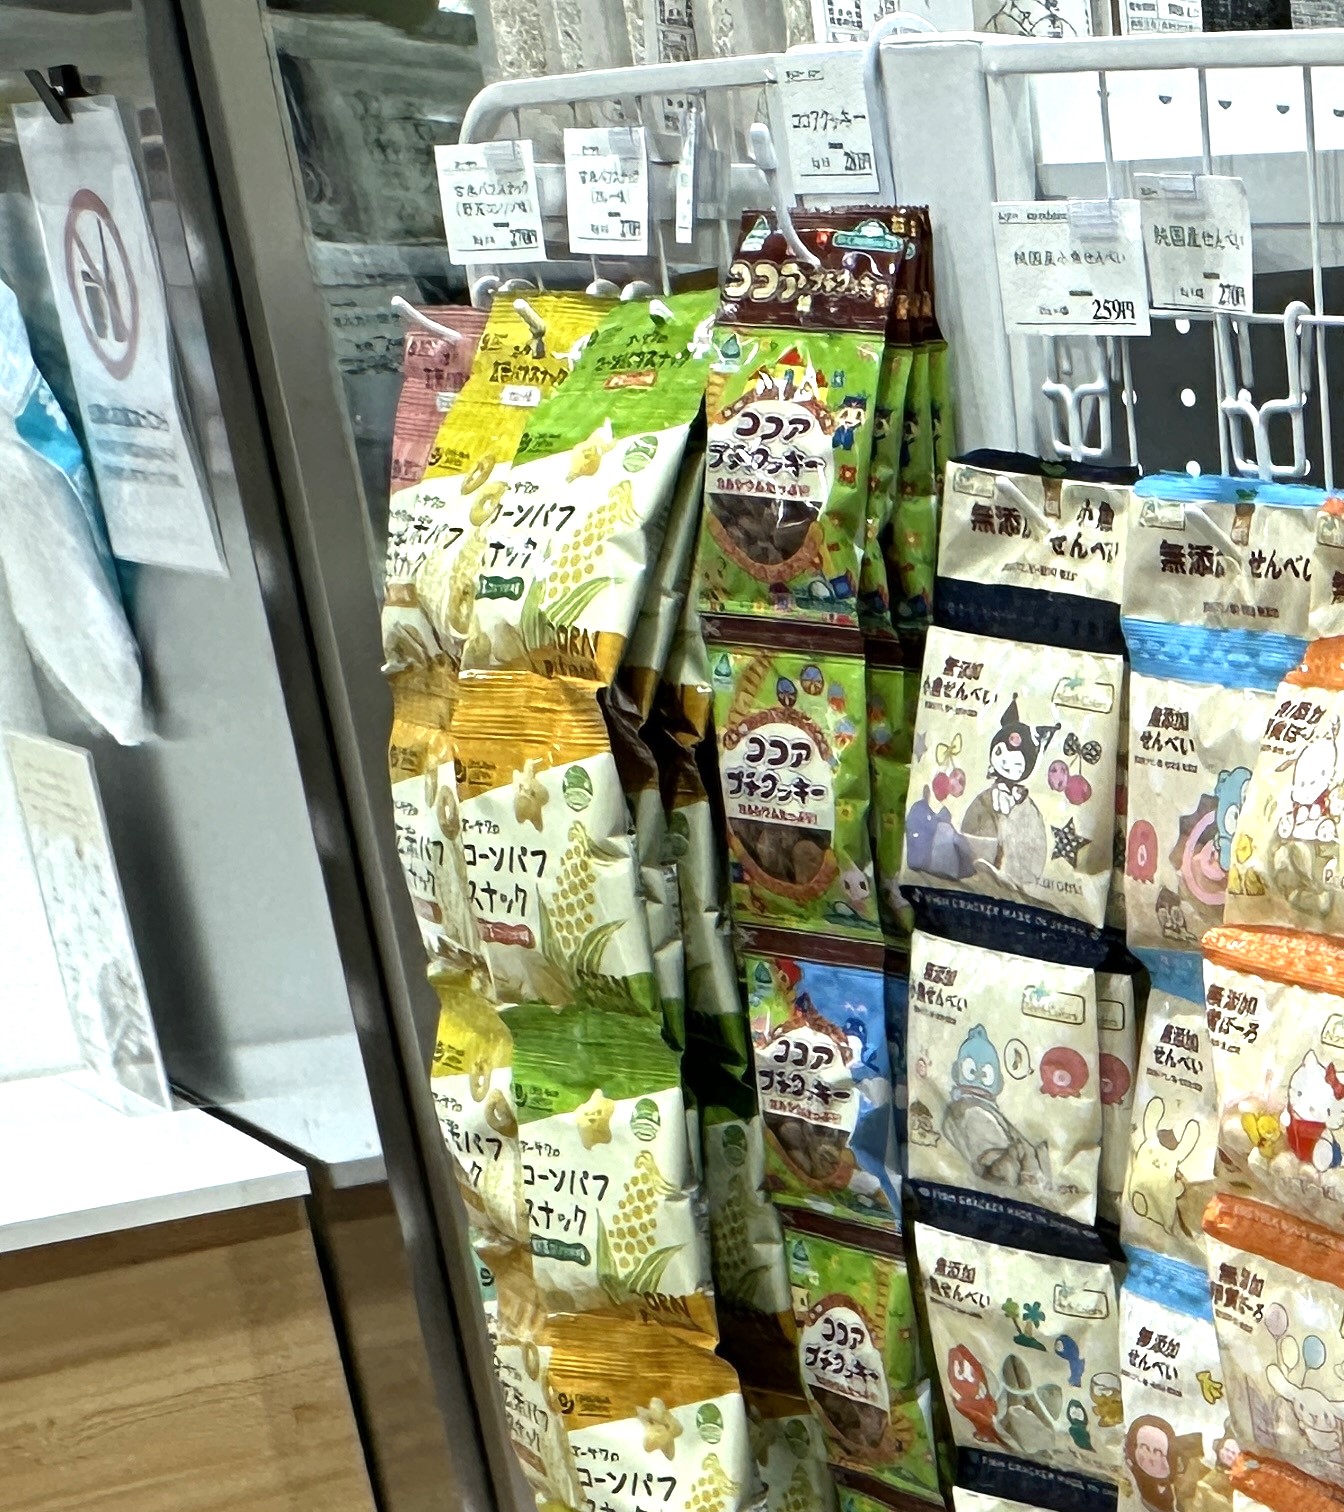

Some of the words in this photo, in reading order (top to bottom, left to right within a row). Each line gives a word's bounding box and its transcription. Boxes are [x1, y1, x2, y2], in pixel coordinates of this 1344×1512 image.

[735, 410, 812, 441] ココア
[746, 736, 812, 768] ココア
[1138, 730, 1196, 755] せんべい
[727, 769, 828, 804] プチクッキー
[463, 843, 548, 878] コーンパフ
[467, 881, 528, 918] スナック
[773, 1040, 834, 1068] ココア
[1154, 1047, 1204, 1075] せんべい
[522, 1164, 610, 1202] コーンパフ
[525, 1198, 586, 1236] スナック
[822, 1316, 866, 1351] ココア
[1128, 1349, 1179, 1381] せんべい
[576, 1467, 677, 1501] コーンパフ
